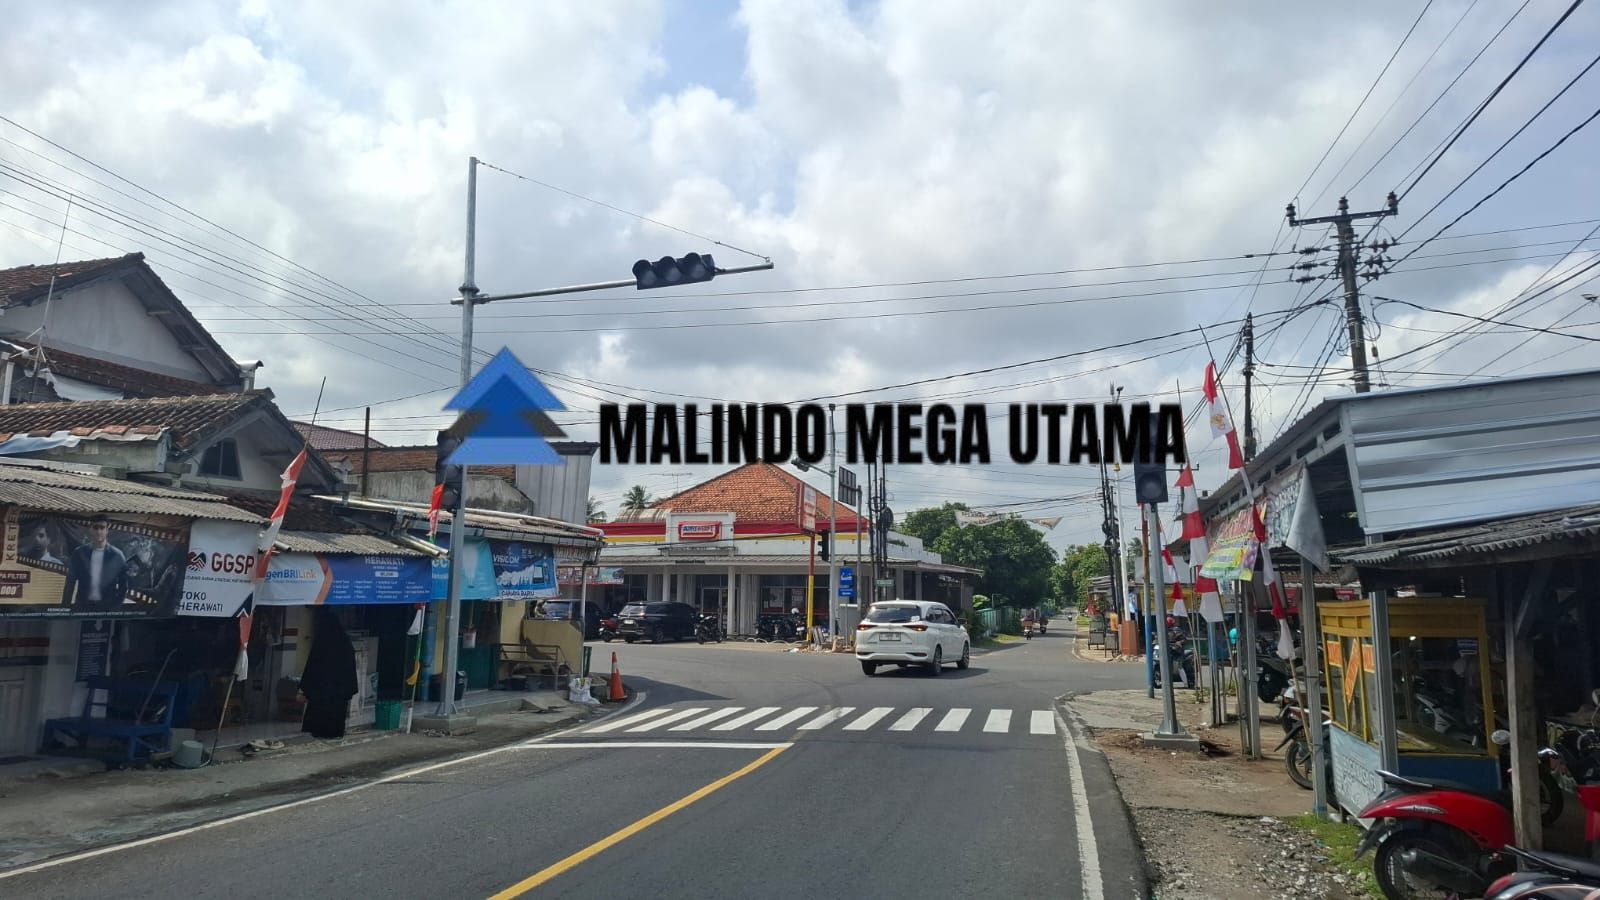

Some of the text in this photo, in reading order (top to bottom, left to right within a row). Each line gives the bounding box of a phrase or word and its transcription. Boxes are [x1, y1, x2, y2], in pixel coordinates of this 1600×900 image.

[211, 552, 255, 575] GGSP
[265, 568, 316, 580] genBRILink
[180, 591, 207, 601] TOKO
[176, 602, 224, 612] HERAWATI
